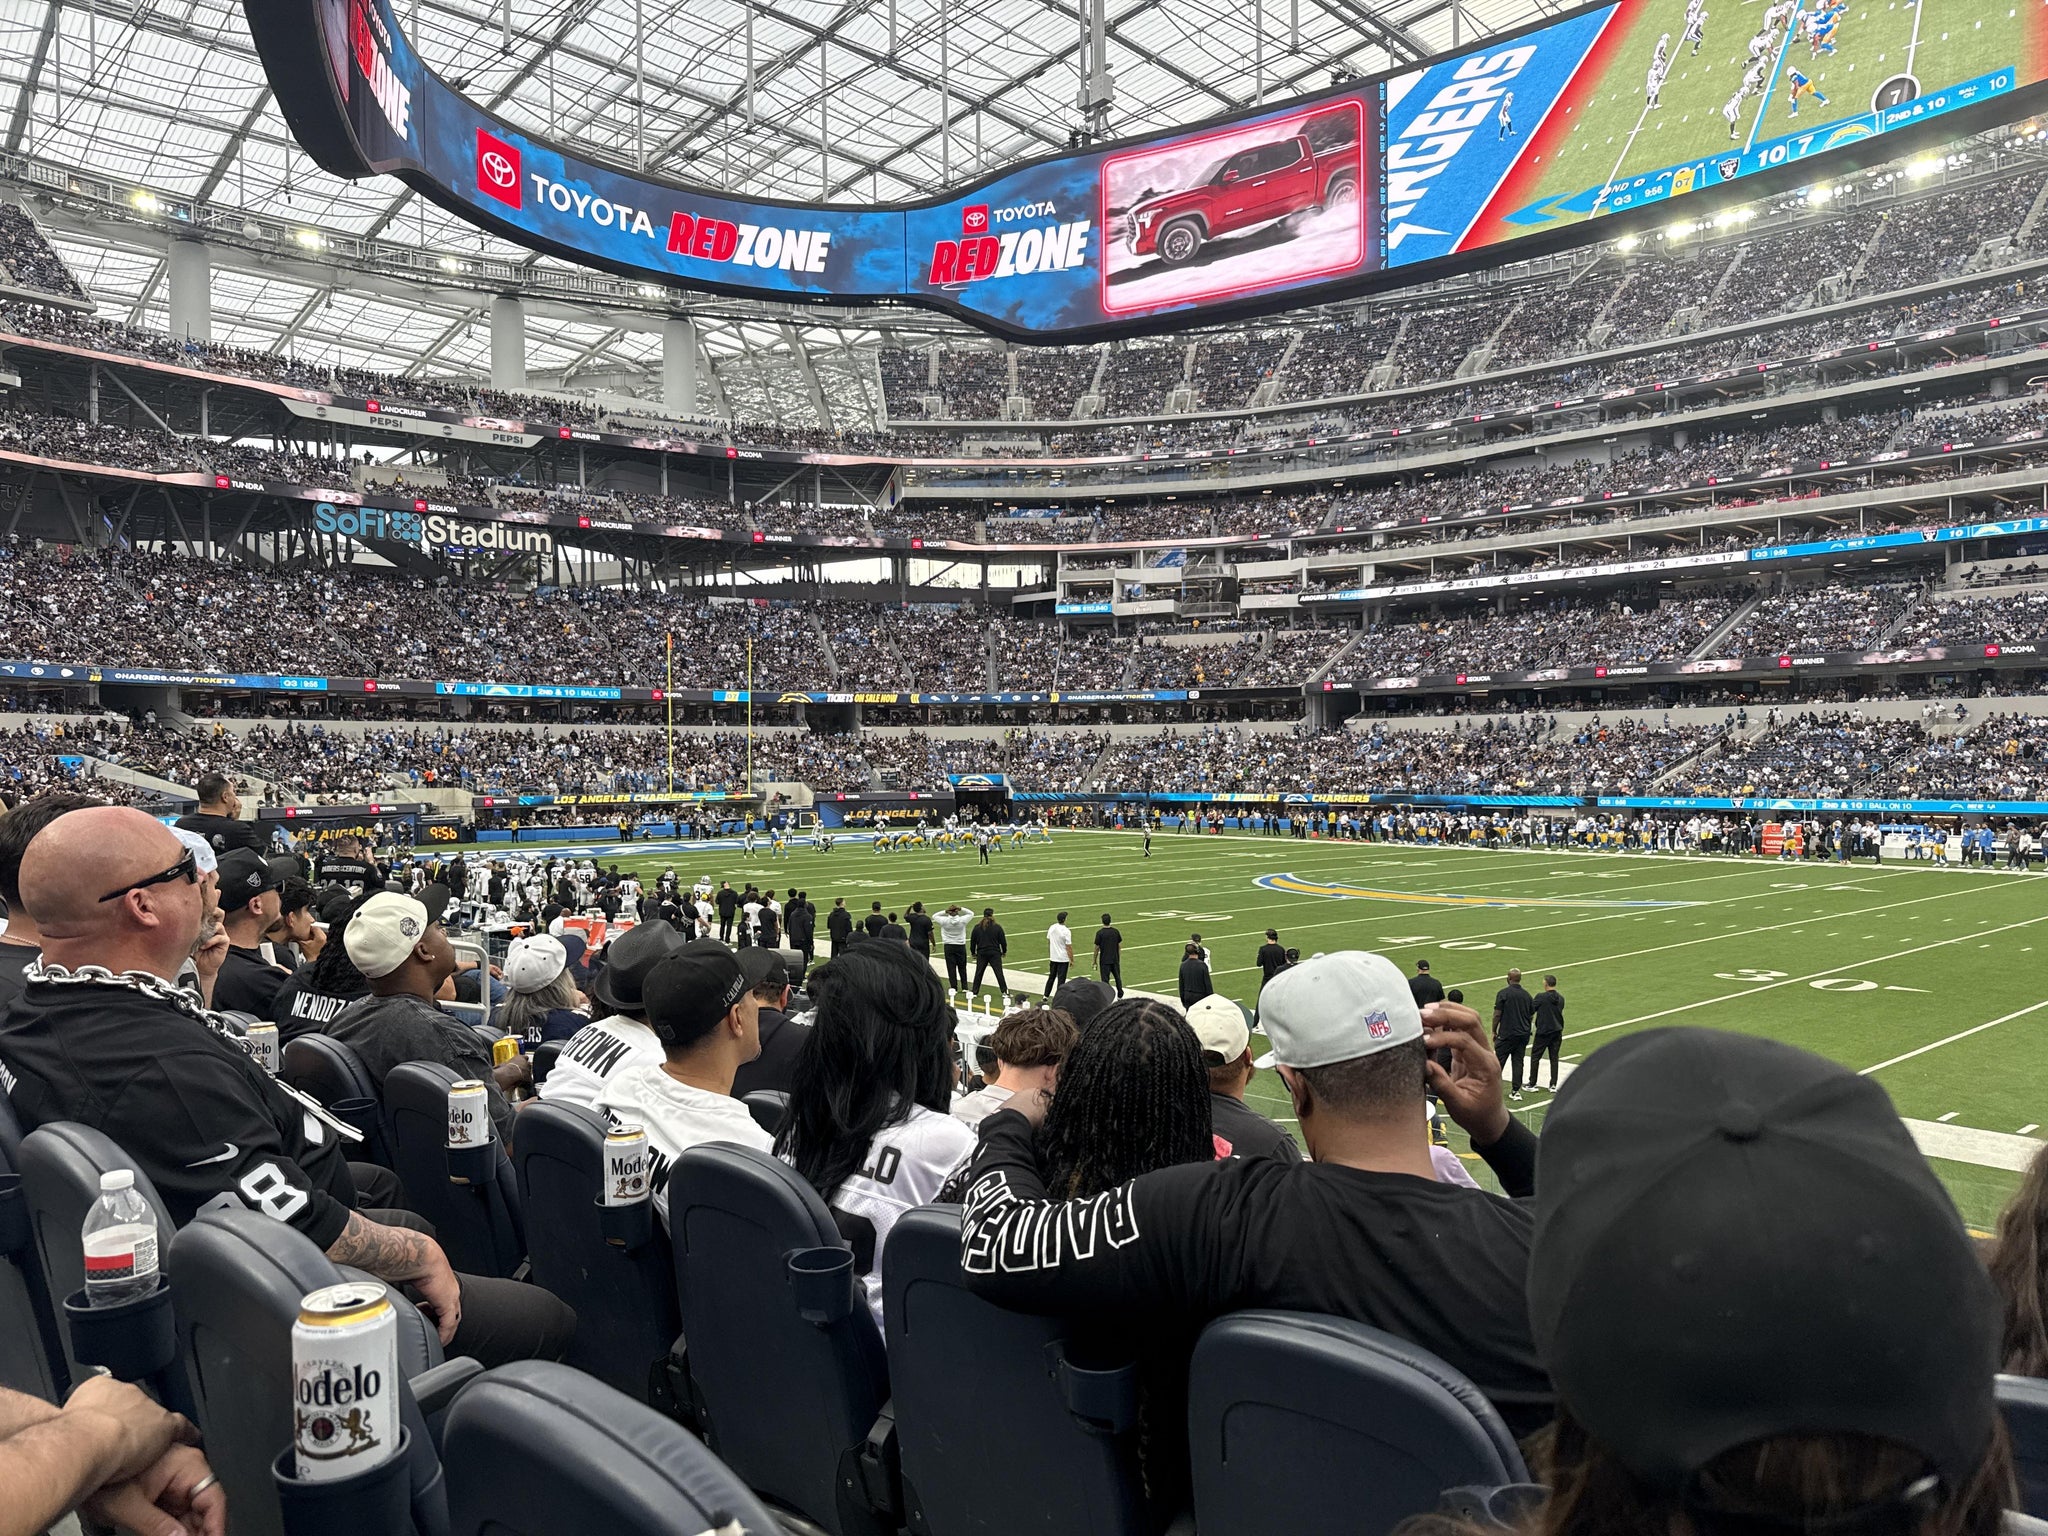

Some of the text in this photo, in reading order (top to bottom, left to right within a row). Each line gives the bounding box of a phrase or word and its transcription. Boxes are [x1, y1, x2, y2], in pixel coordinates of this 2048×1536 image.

[1989, 76, 2008, 91] 10
[1889, 89, 1901, 106] 7
[1758, 145, 1785, 167] 10
[1797, 136, 1814, 154] 7
[1887, 108, 1911, 124] 2ND
[1928, 97, 1946, 110] 10
[1613, 195, 1632, 206] Q3
[1644, 185, 1663, 198] 9:56
[994, 201, 1056, 223] TOYOTA
[531, 173, 831, 273] TOYOTA REDZONE
[929, 220, 1090, 285] REDZONE
[380, 405, 427, 418] LANDCRUISER
[369, 416, 403, 428] PEPSI
[492, 433, 523, 445] PEPSI
[572, 431, 601, 441] 4RUNNER
[738, 450, 763, 459] TACOMA
[232, 480, 265, 492] TUNDRA
[315, 503, 552, 552] SoFi Stadium
[591, 521, 633, 531] LANDCRUISER
[1722, 553, 1734, 561] 17
[1653, 560, 1665, 569] 24
[1527, 573, 1538, 581] 34
[2001, 644, 2036, 654] TACOMA
[1792, 656, 1825, 666] 4RUNNER
[1607, 667, 1647, 675] LANDCRUISER
[610, 690, 619, 698] 10
[827, 693, 853, 703] TICKETS
[864, 694, 880, 703] SALE
[553, 795, 577, 804] LOS
[579, 794, 631, 804] ANGELES
[1212, 793, 1231, 802] LOS
[1312, 794, 1371, 803] CHARGERS
[877, 809, 927, 819] ANGELE
[429, 826, 458, 840] 9:56
[579, 873, 591, 884] 58
[1370, 1020, 1390, 1037] NFL
[612, 1156, 648, 1176] Mode
[294, 1361, 381, 1406] odelo
